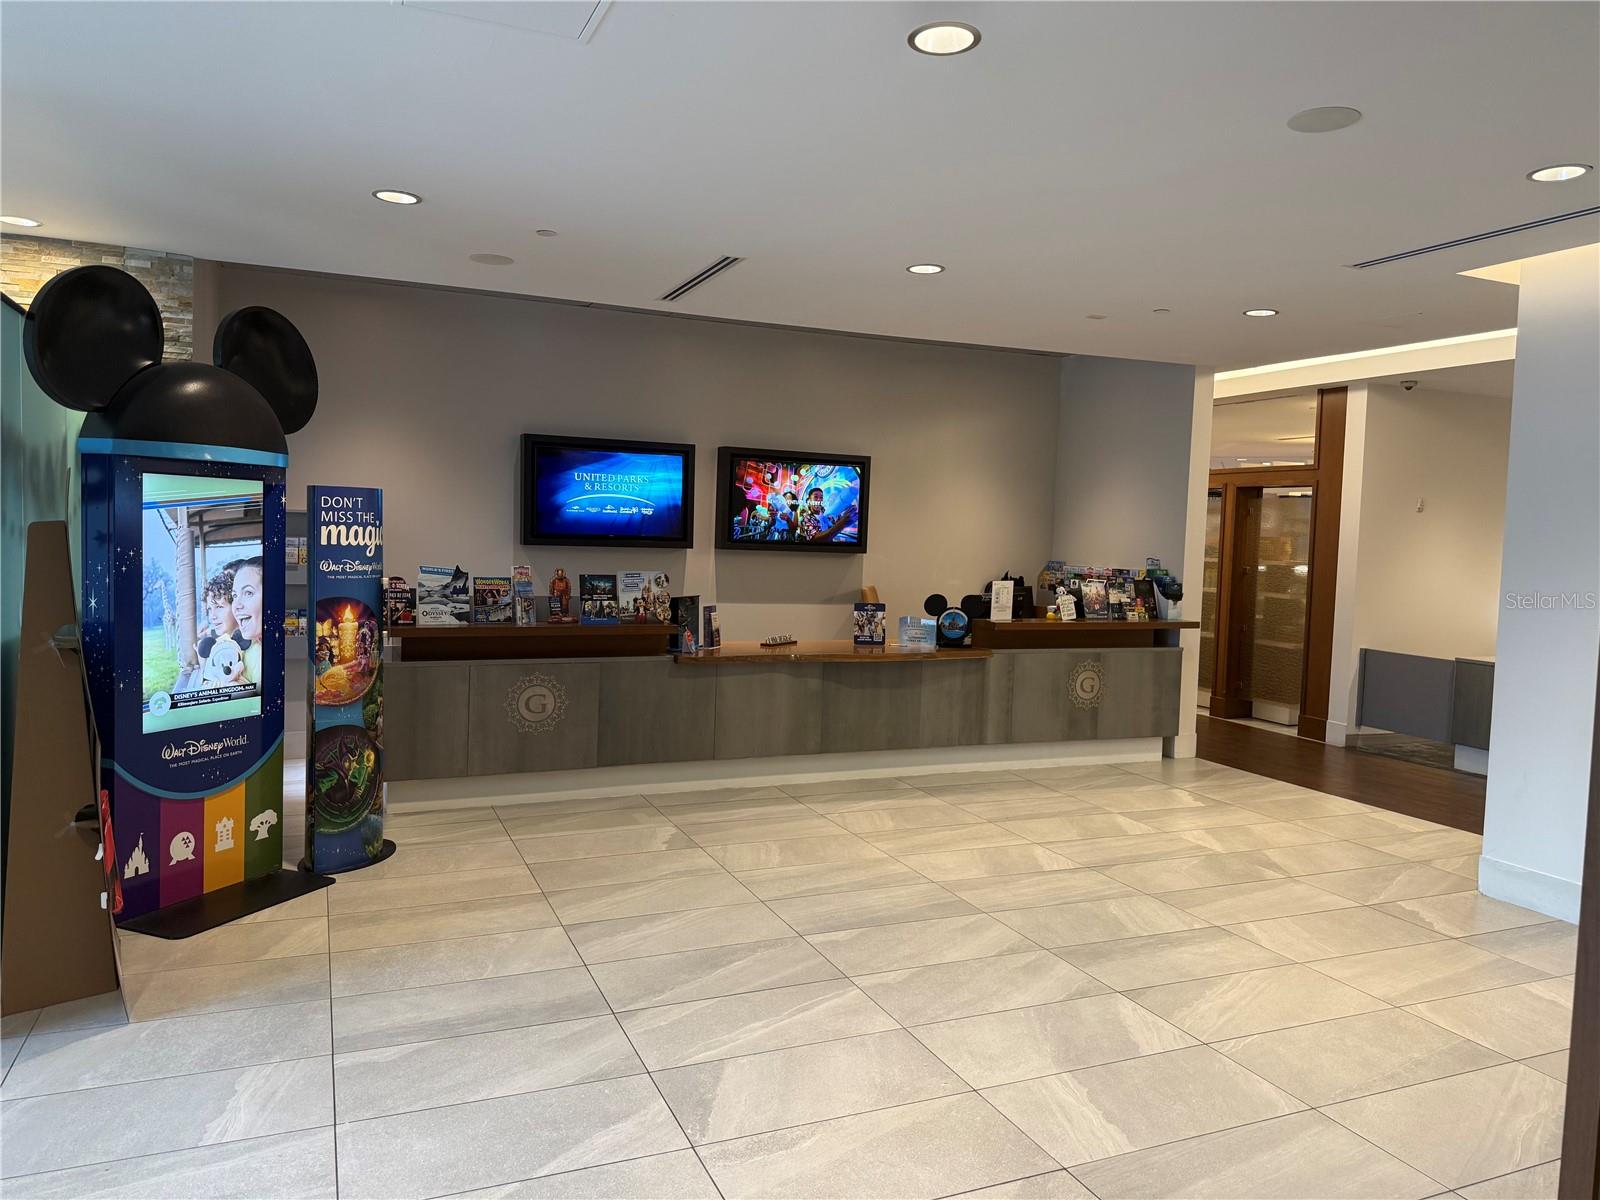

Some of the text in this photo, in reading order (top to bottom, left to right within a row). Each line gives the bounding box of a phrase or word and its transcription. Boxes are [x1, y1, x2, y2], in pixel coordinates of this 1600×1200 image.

[574, 472, 649, 483] UNITED PARKS
[584, 482, 640, 492] & RESORTS
[321, 496, 363, 509] DON'T
[321, 511, 375, 523] MISS THE
[1080, 676, 1096, 693] G
[174, 691, 198, 700] DISNEY'S
[198, 689, 219, 697] ANIMAL
[524, 693, 547, 714] G
